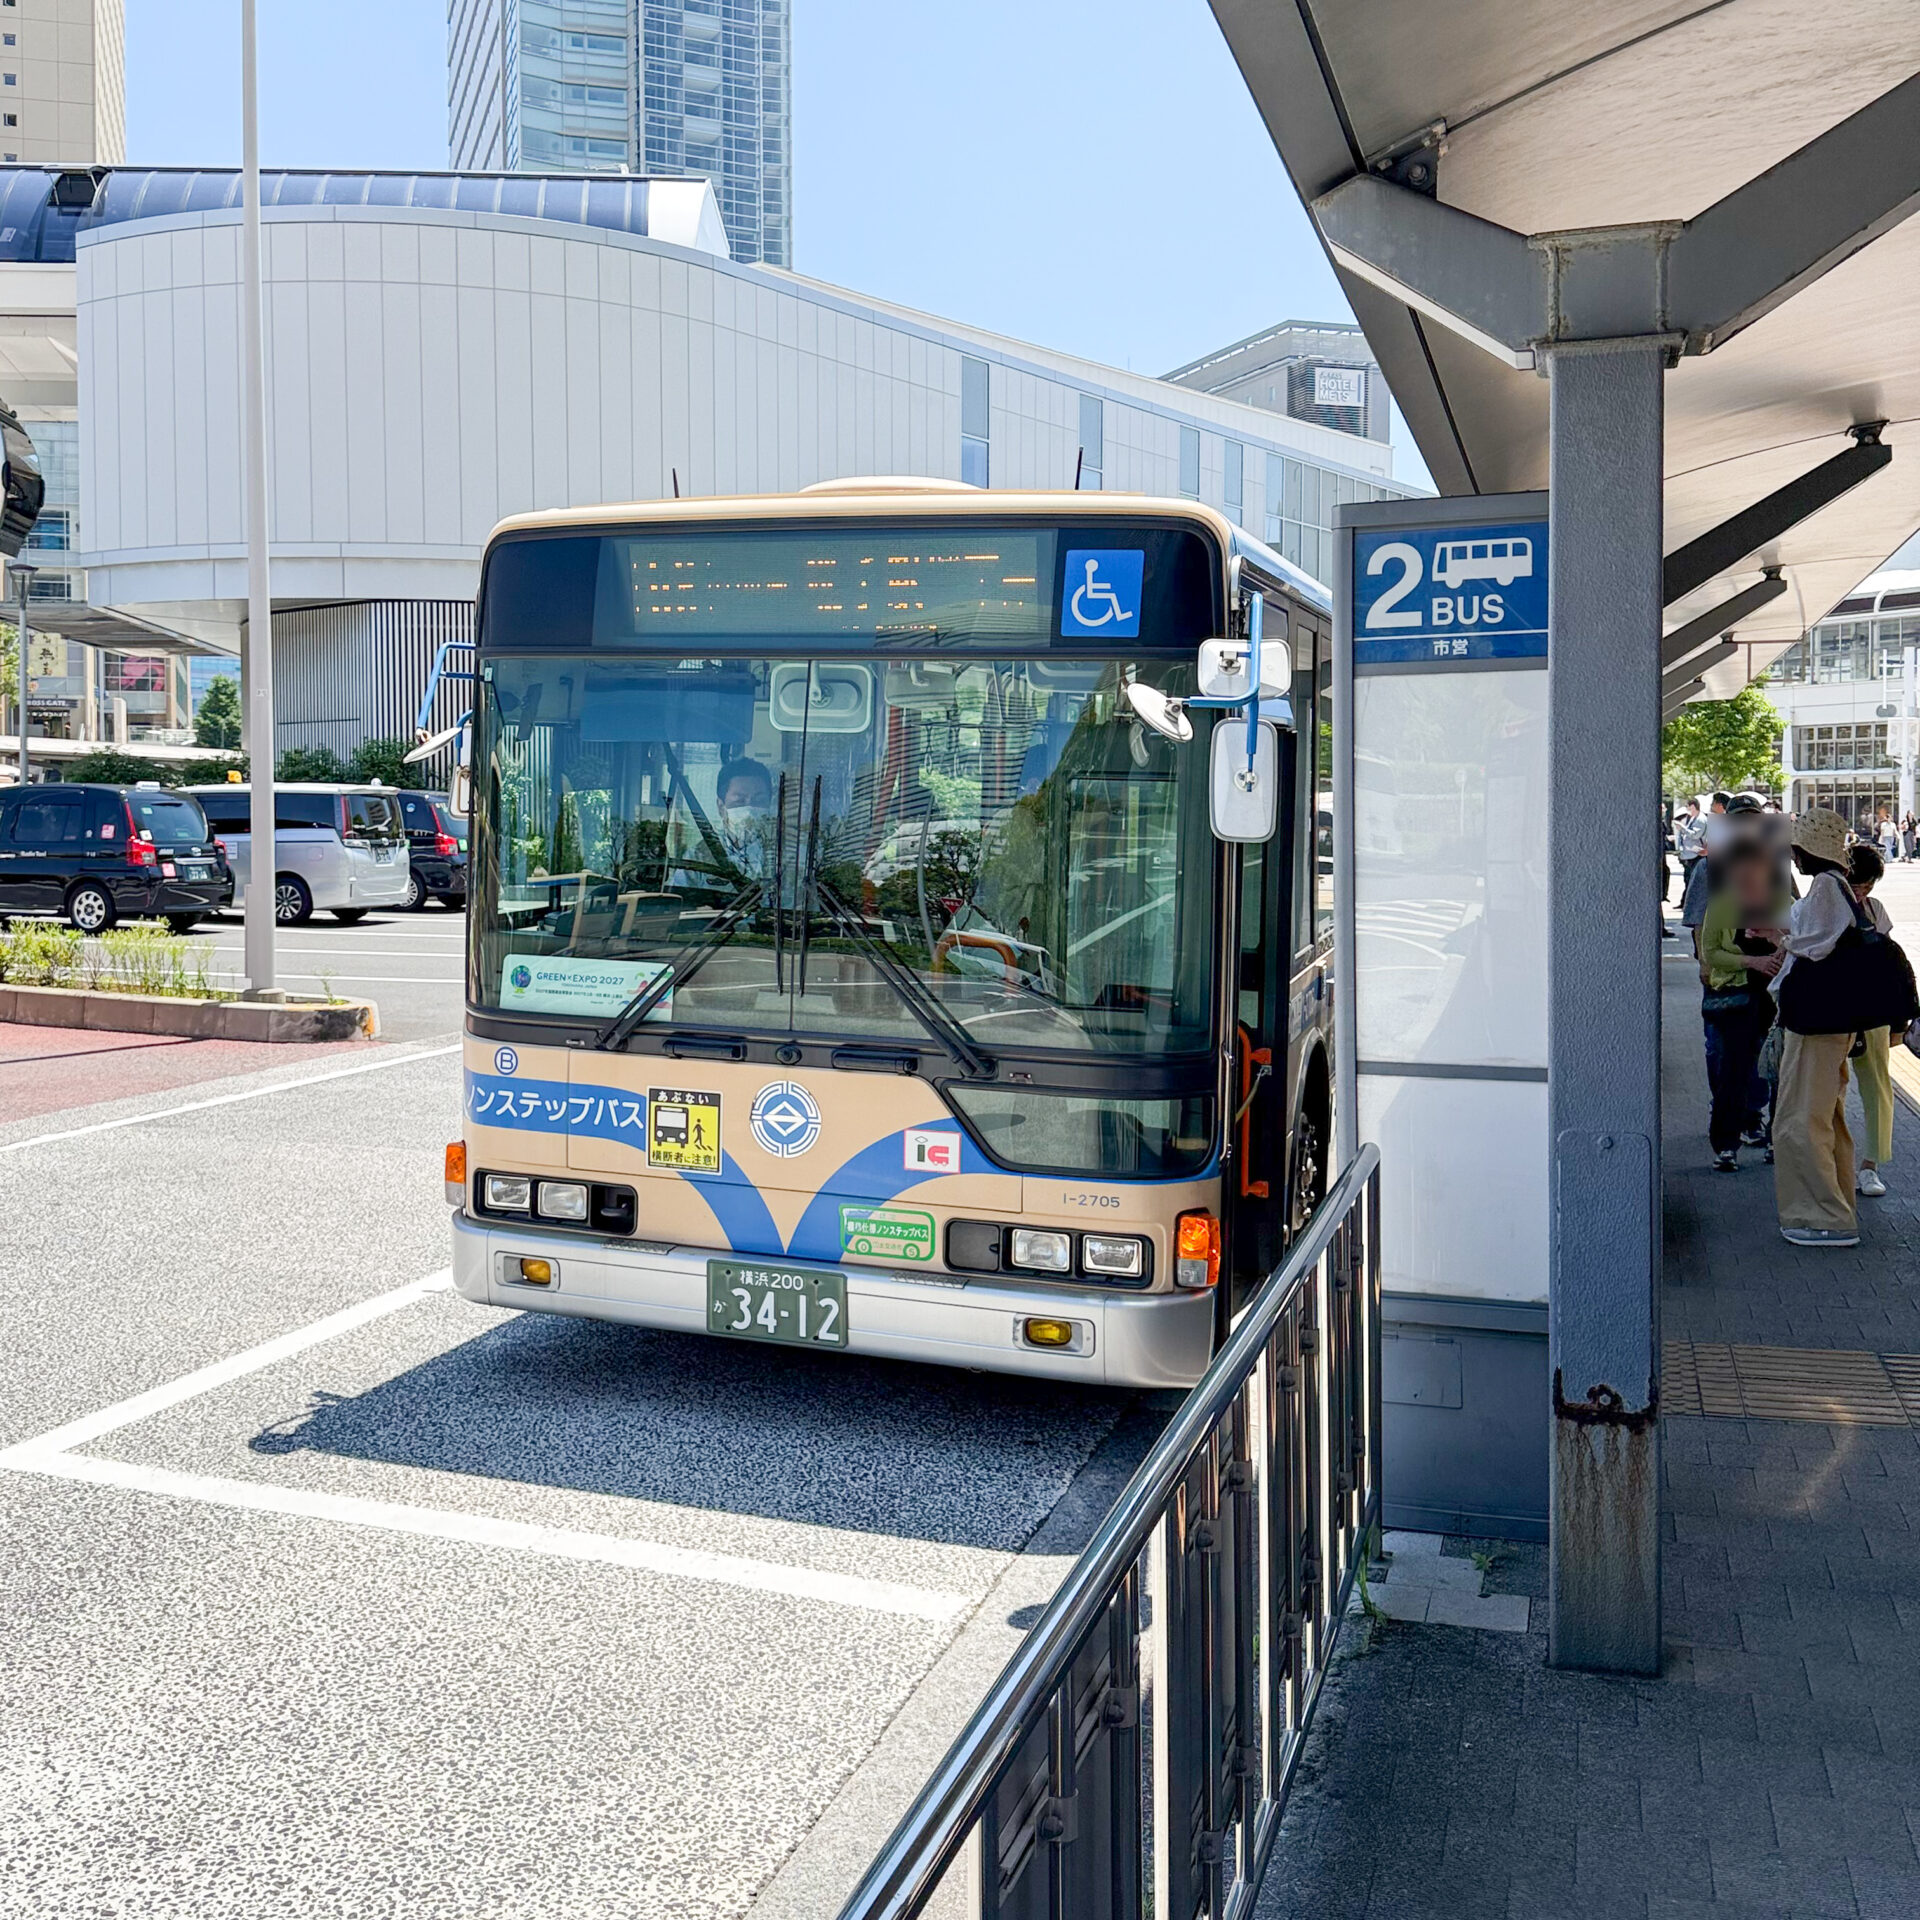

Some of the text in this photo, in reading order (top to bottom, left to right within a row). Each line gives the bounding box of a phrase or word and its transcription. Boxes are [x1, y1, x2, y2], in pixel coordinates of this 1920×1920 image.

[1319, 379, 1356, 391] HOTEL
[1319, 389, 1351, 402] METS
[1365, 542, 1424, 629] 2
[1432, 594, 1505, 627] BUS
[1433, 639, 1469, 656] 市営
[599, 976, 625, 985] 2027
[657, 1090, 710, 1105] あぶない
[467, 1084, 645, 1130] ノンステップバス
[713, 1287, 840, 1341] か 34-12
